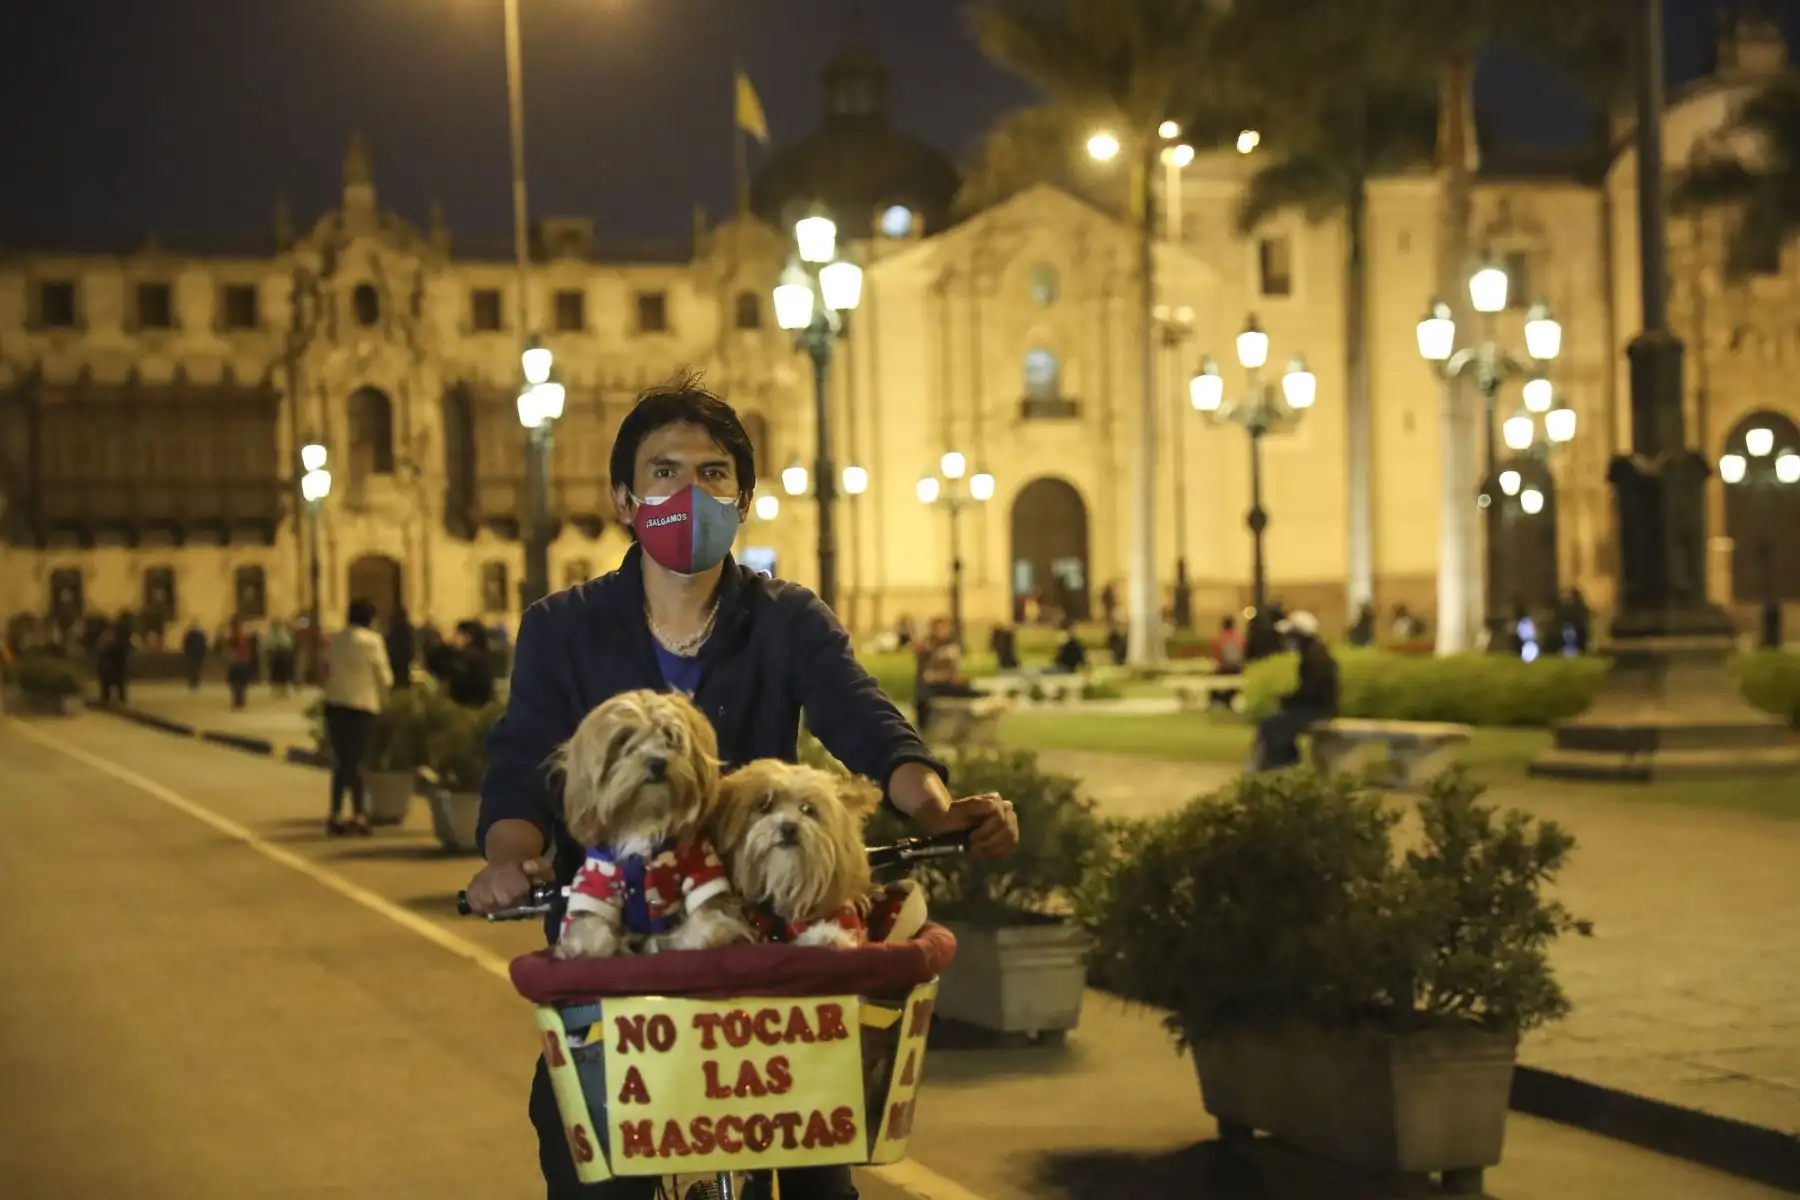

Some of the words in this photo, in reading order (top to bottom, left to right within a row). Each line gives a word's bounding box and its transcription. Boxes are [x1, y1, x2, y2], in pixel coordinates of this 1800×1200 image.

[615, 1013, 676, 1053] NO
[692, 1003, 848, 1050] TOCAR
[618, 1065, 651, 1105] A
[702, 1055, 793, 1100] LAS
[618, 1106, 857, 1158] MASCOTAS
